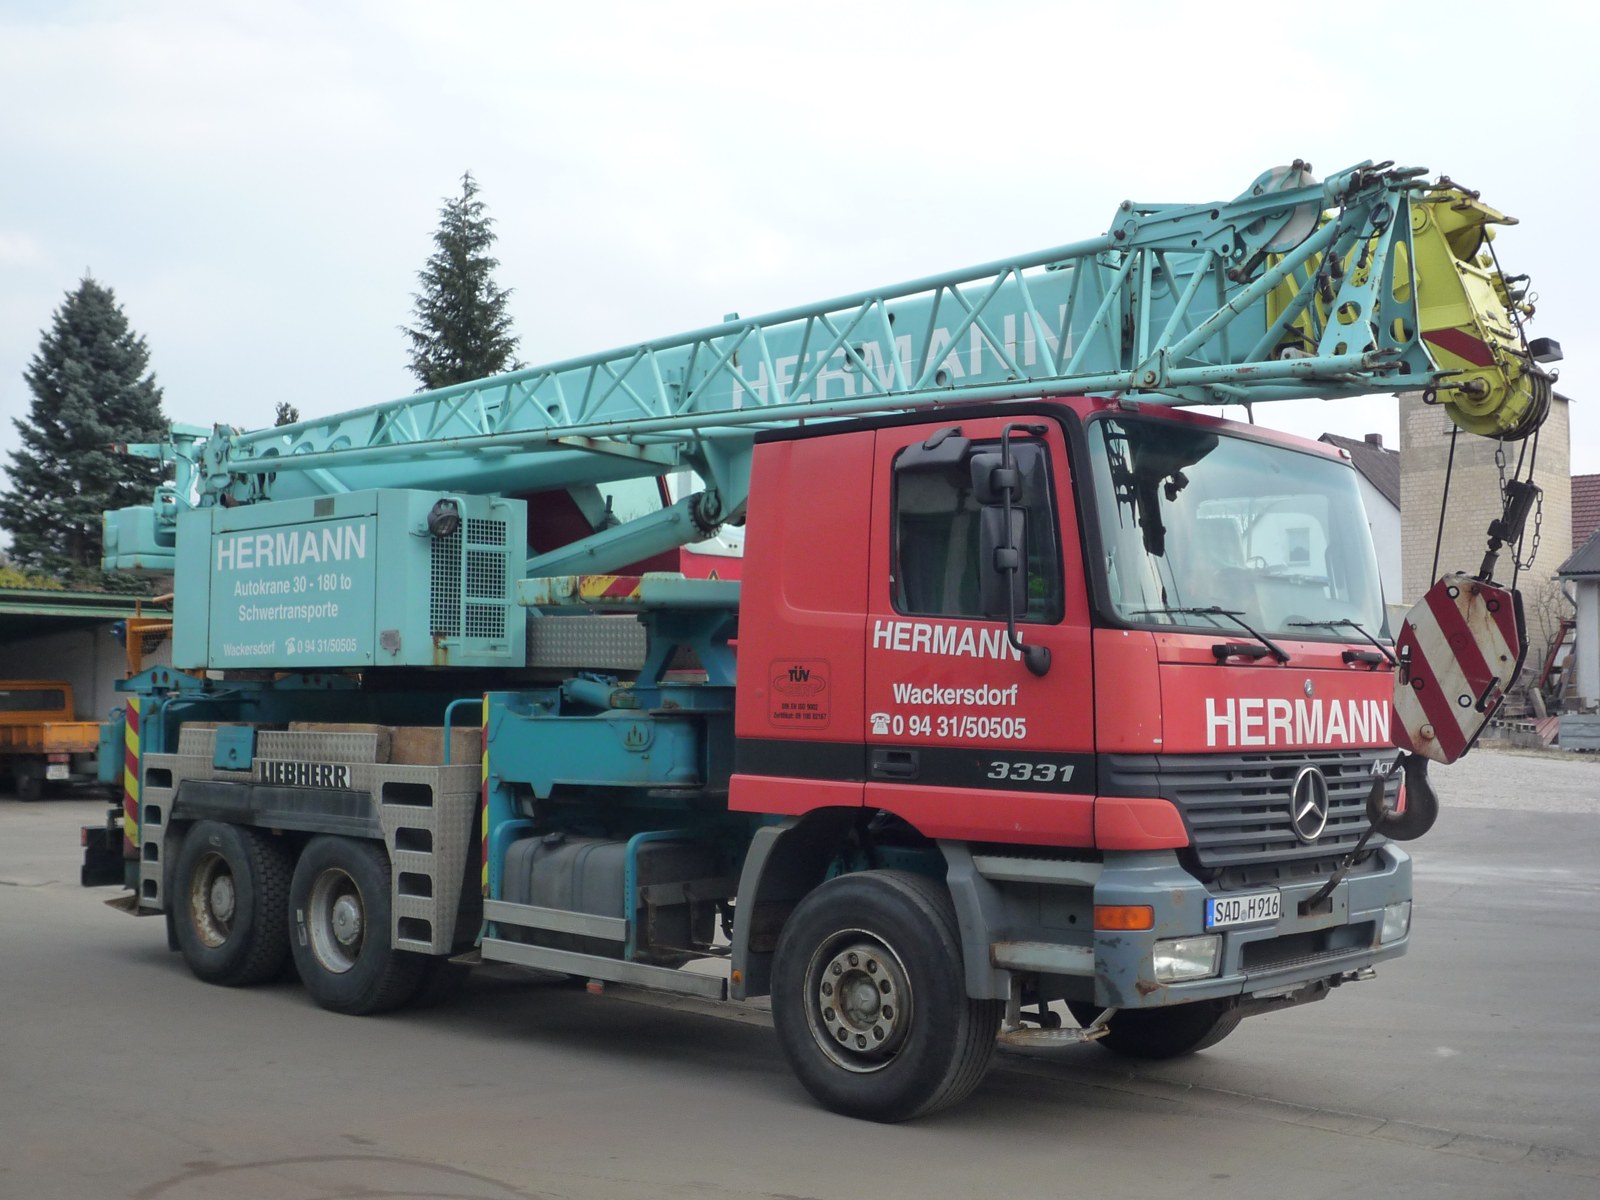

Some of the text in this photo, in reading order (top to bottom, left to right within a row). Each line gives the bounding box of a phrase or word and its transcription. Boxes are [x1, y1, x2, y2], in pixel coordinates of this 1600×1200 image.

[732, 304, 1073, 409] HERMANN
[217, 524, 366, 571] HERMANN
[234, 579, 290, 596] Autokrane
[293, 576, 306, 593] 30
[317, 573, 337, 591] 180
[340, 573, 351, 590] to
[238, 601, 338, 623] Schwertransporte
[223, 638, 357, 657] Wackersdorf 0 94 31/50505
[873, 620, 1023, 661] HERMANN
[788, 666, 810, 682] TÜV
[893, 683, 1018, 706] Wackersdorf
[893, 715, 1026, 739] 0 94 31/50505
[1206, 698, 1389, 746] HERMANN
[260, 761, 348, 788] LIEBHERR
[987, 761, 1075, 782] 3331
[1215, 901, 1240, 922] SAD
